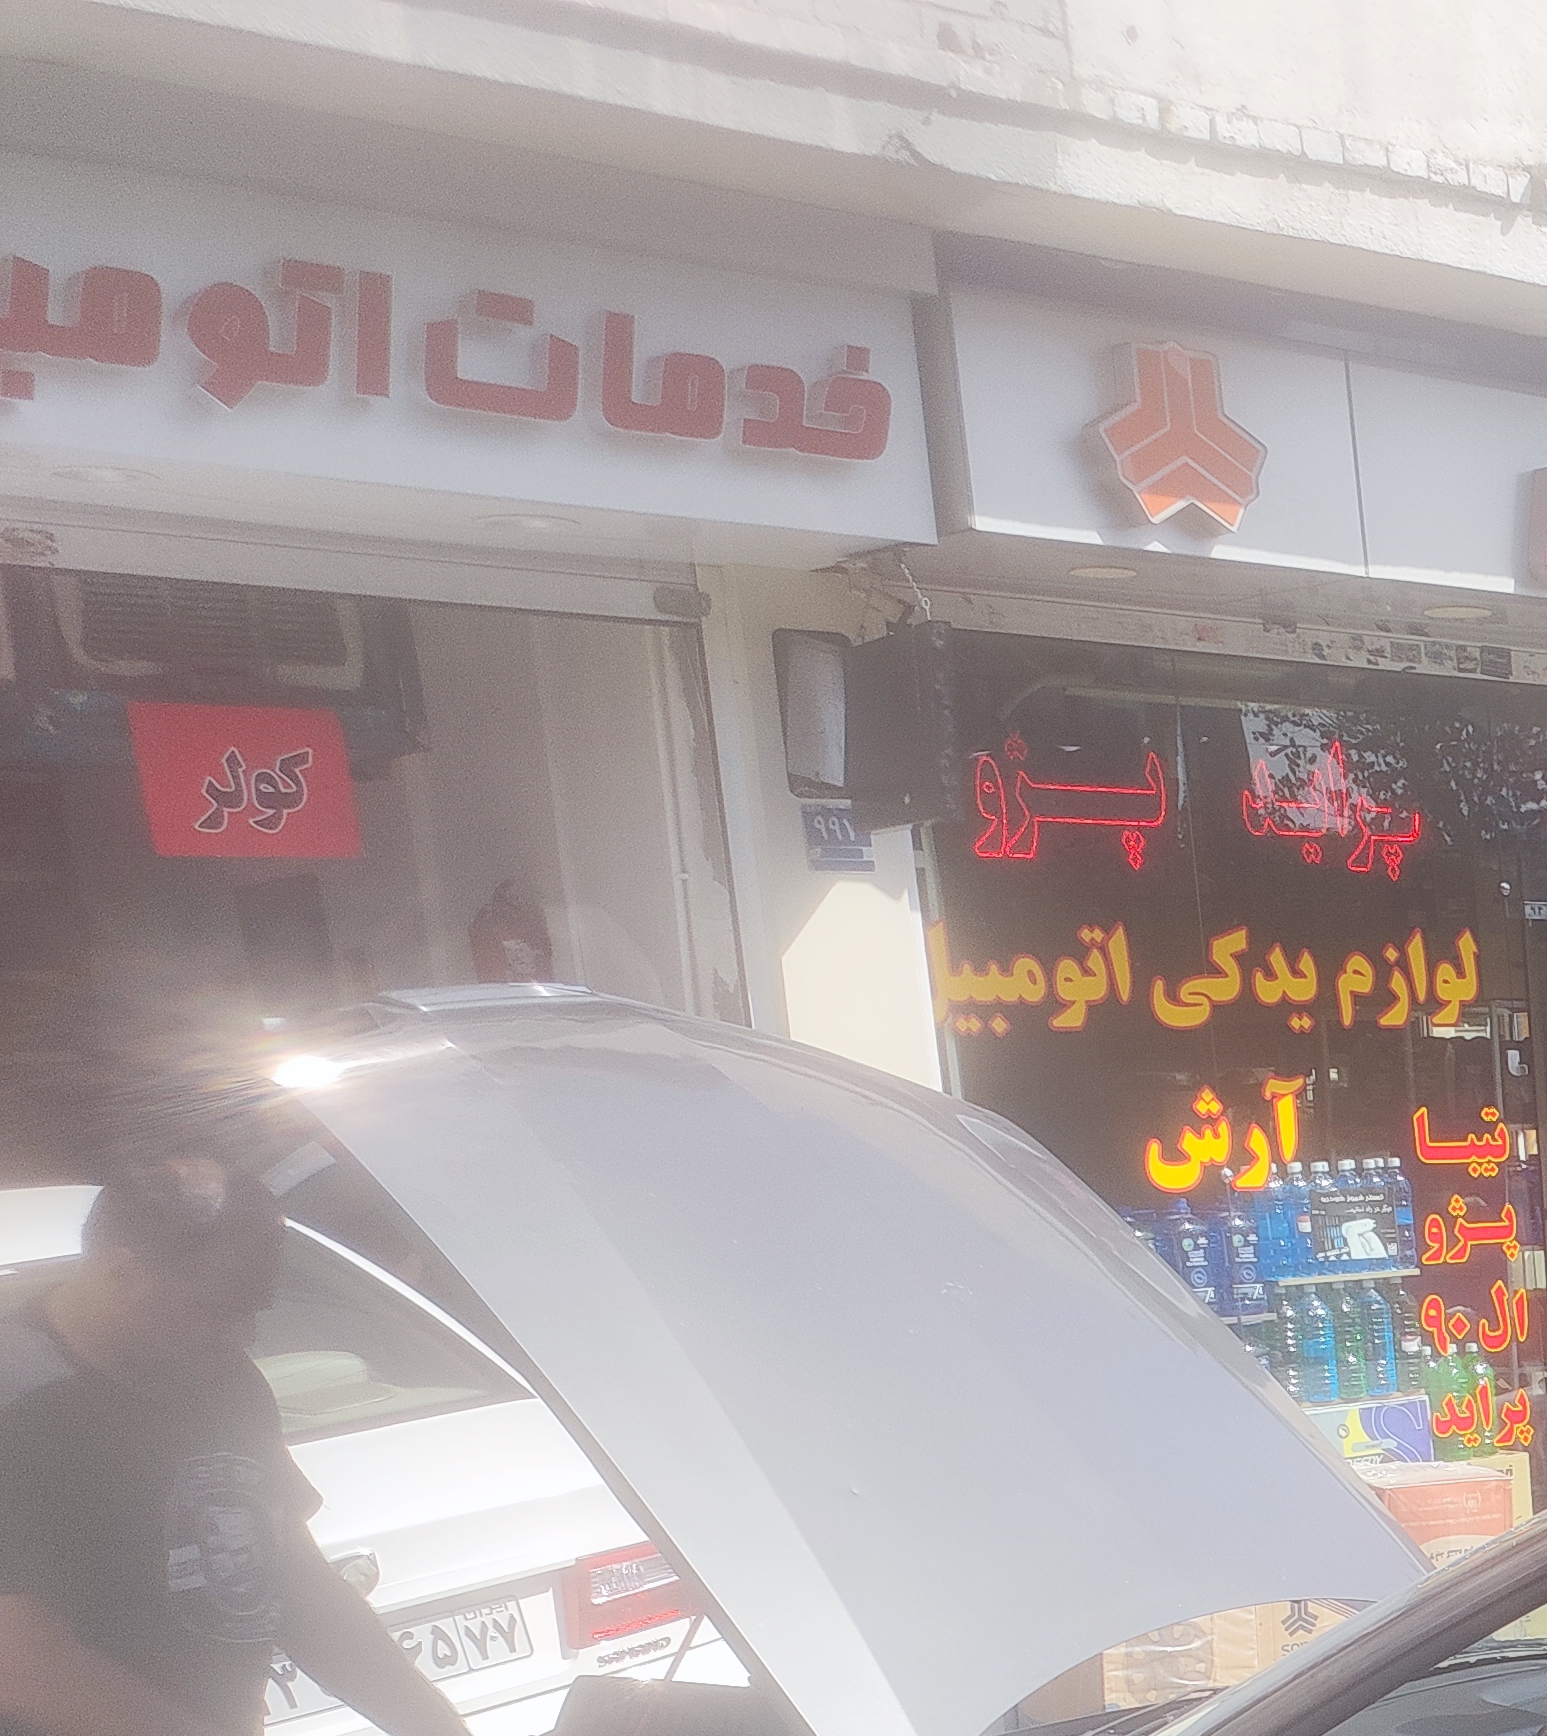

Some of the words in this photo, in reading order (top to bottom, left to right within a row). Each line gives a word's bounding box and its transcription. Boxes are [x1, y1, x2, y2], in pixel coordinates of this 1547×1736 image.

[425, 289, 893, 461] خدمات
[195, 748, 312, 833] کولر
[814, 815, 855, 841] ۹۹۱
[973, 730, 1166, 870] پژو
[1150, 926, 1319, 1033] یدکی
[1334, 926, 1480, 1030] لوازم
[1145, 1076, 1306, 1193] آرش
[1413, 1105, 1510, 1178] تیبا
[1421, 1193, 1520, 1264] پژو
[1432, 1376, 1534, 1448] پراید
[463, 1613, 519, 1661] ۷۷
